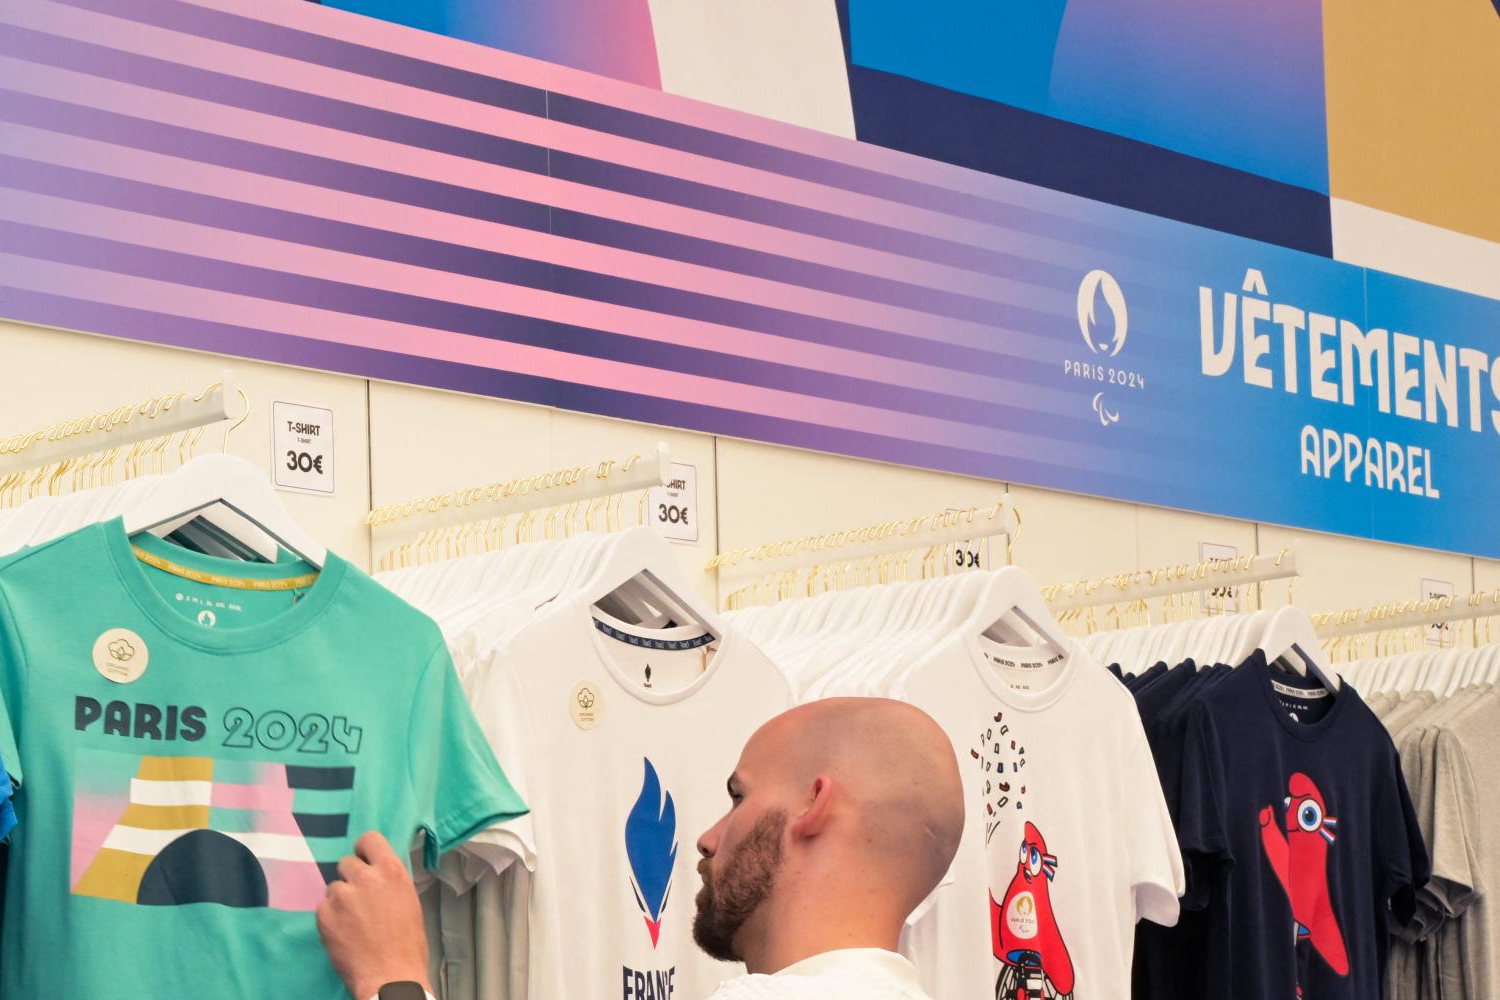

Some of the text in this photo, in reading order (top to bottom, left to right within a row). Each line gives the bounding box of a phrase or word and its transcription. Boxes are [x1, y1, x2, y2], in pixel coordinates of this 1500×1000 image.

[1107, 366, 1146, 390] 2024
[287, 420, 320, 436] T-SHIRT
[286, 450, 324, 475] 30€
[1301, 424, 1440, 499] APPAREL
[658, 503, 689, 525] 30€
[74, 695, 363, 754] PARIS 2024
